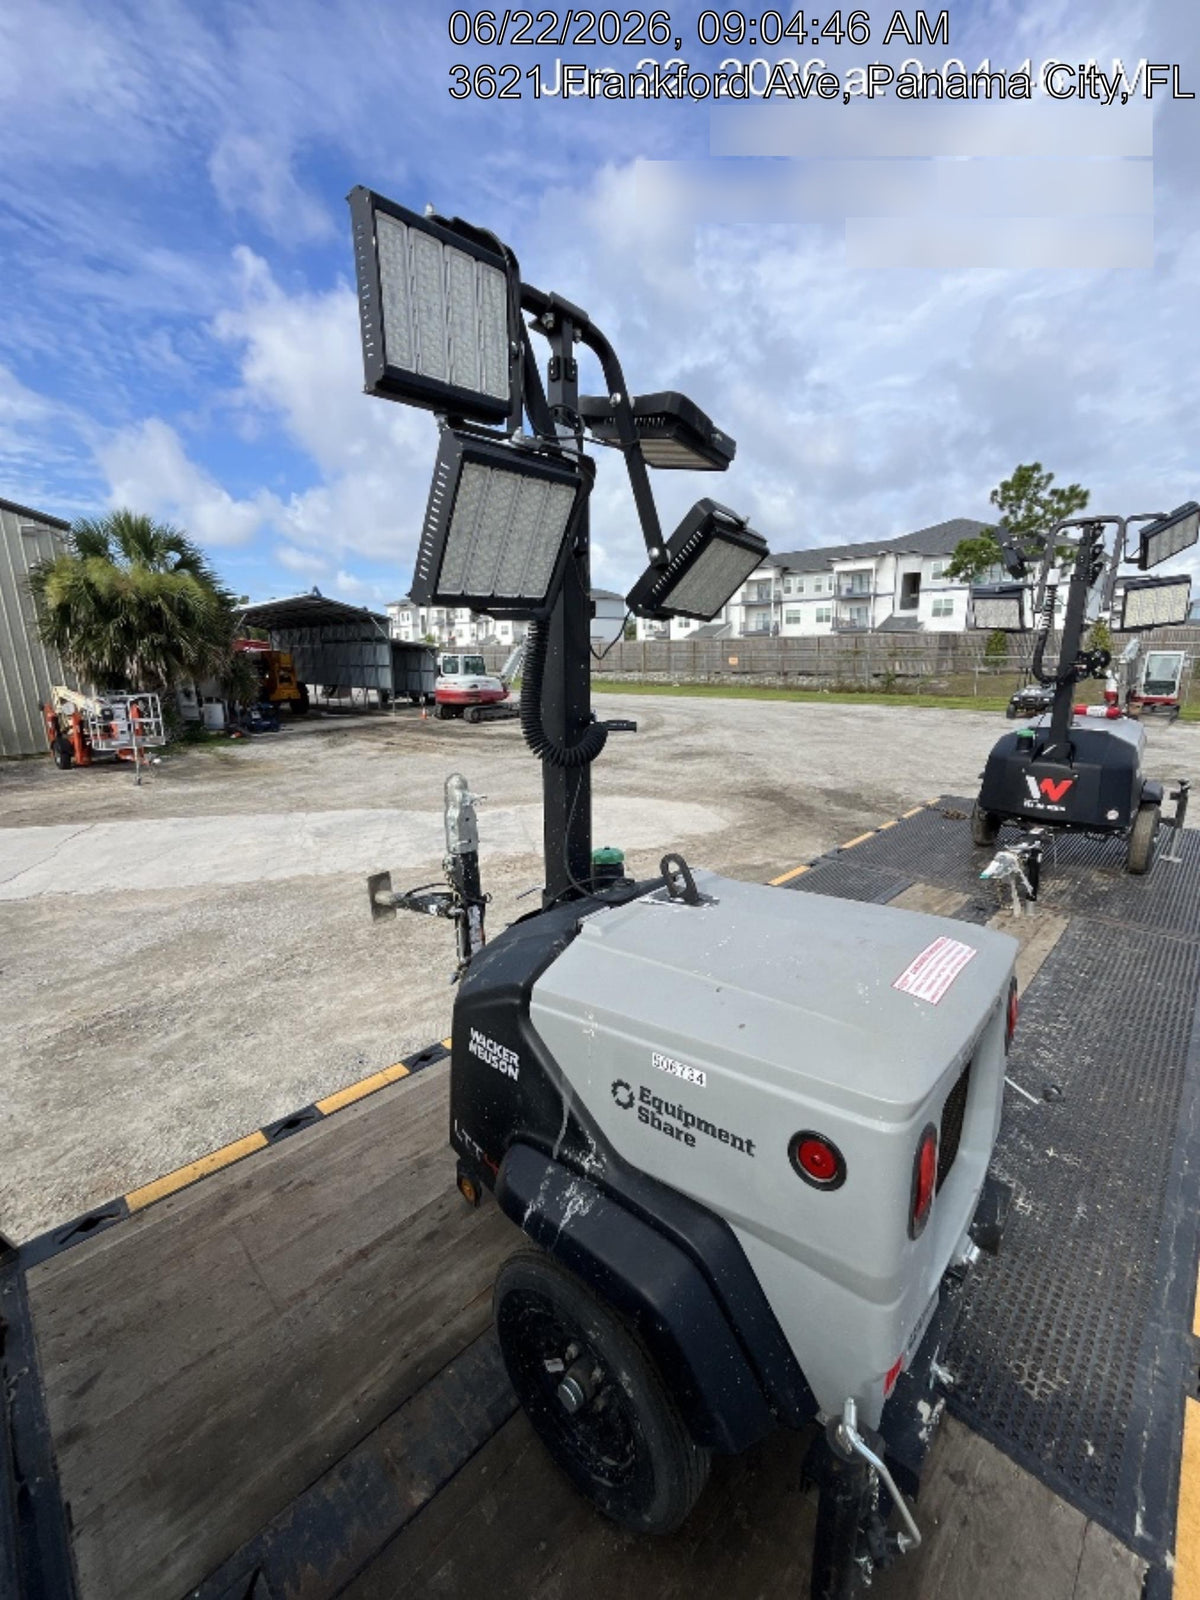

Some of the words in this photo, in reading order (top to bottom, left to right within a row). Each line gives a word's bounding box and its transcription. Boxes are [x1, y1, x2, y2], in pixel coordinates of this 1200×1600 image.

[468, 1039, 519, 1082] NEUSON
[470, 1027, 519, 1068] WACKER
[637, 1106, 697, 1148] Share
[639, 1085, 756, 1157] Equipment
